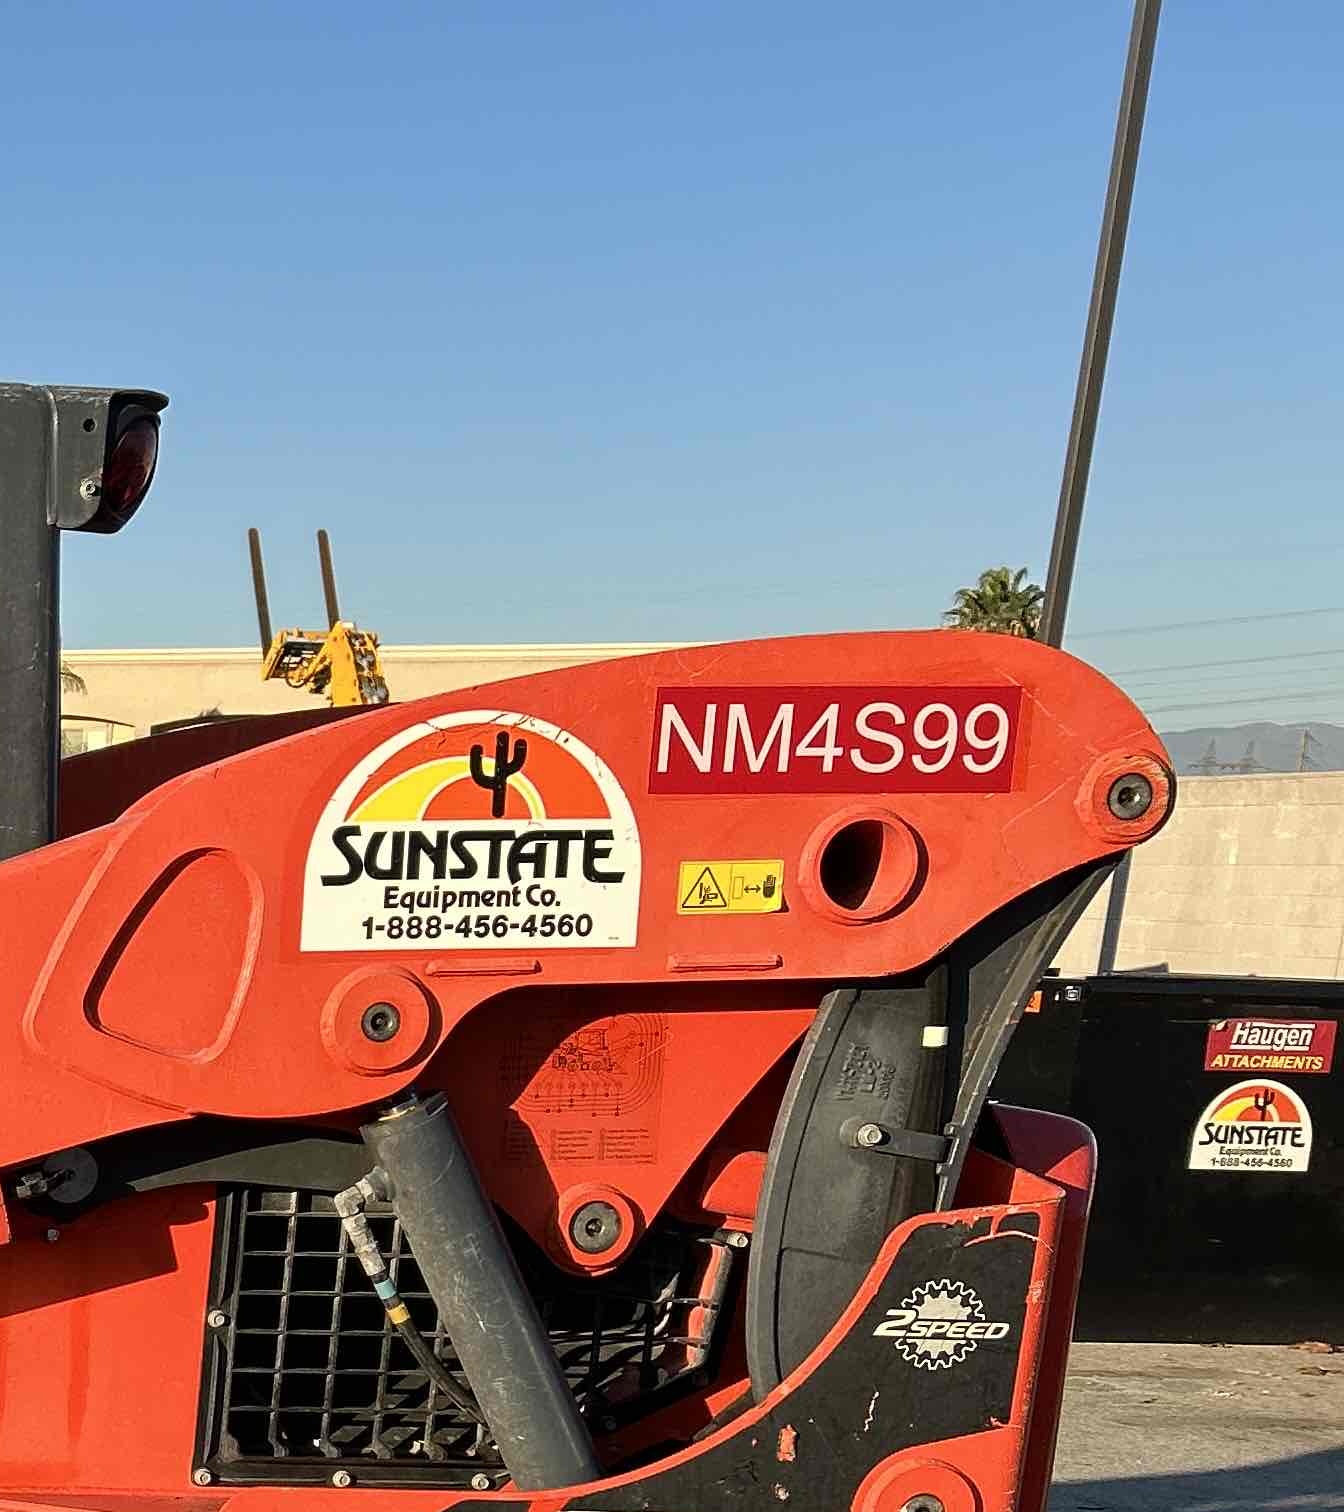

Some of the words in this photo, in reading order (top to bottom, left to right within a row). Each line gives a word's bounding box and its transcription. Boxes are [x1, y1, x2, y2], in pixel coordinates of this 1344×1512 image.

[656, 702, 1013, 776] NM4S99
[319, 824, 626, 886] SUNSTATE
[383, 884, 521, 914] Equipment
[526, 883, 561, 908] Co.
[361, 913, 594, 940] 1-888-456-4560
[1231, 1021, 1314, 1051] Haugen
[1210, 1054, 1324, 1071] ATTACHMENTS
[1198, 1122, 1306, 1149] SUNSTATE
[1210, 1157, 1294, 1168] 1-888-456-4560
[1219, 1147, 1268, 1157] Equipment
